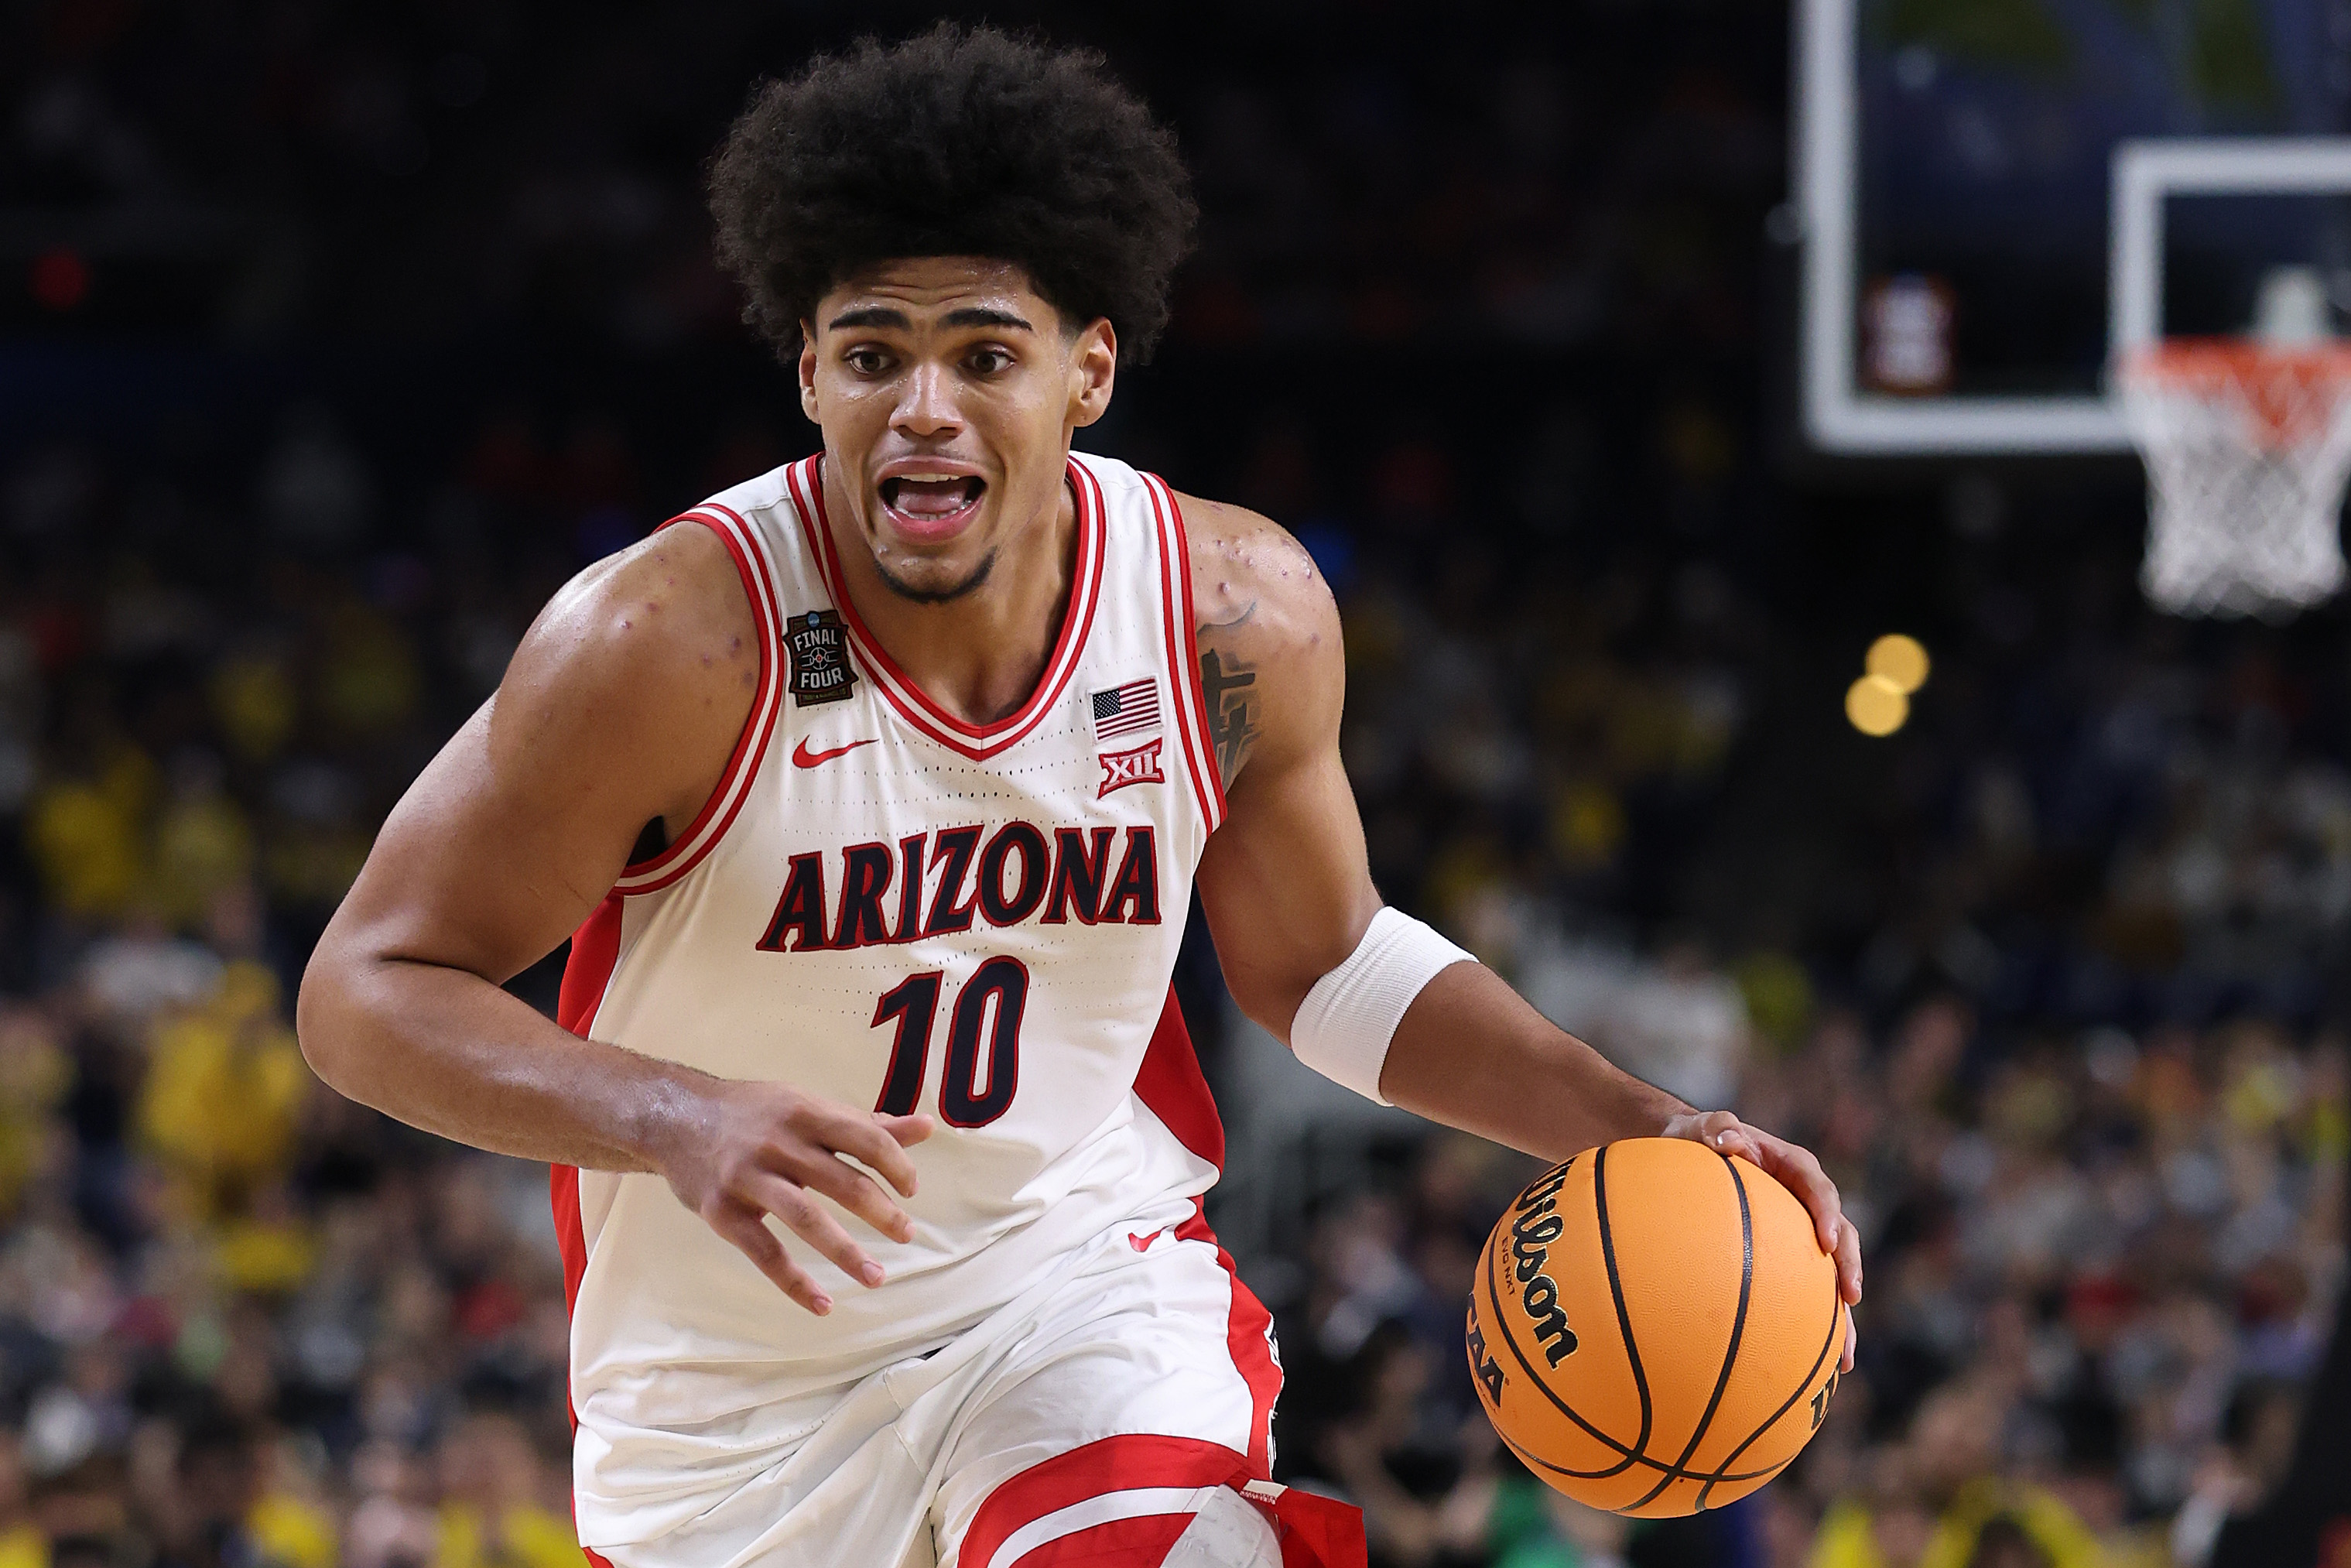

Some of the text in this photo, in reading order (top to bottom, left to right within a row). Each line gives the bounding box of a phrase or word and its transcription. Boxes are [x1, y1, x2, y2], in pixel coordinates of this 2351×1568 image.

[793, 628, 838, 652] FINAL
[800, 667, 844, 689] FOUR
[1099, 740, 1162, 795] XII
[755, 820, 1162, 952] ARIZONA
[871, 954, 1030, 1128] 10
[1504, 1266, 1515, 1295] NXT
[1512, 1155, 1579, 1371] Wilson
[1467, 1286, 1505, 1408] CAA
